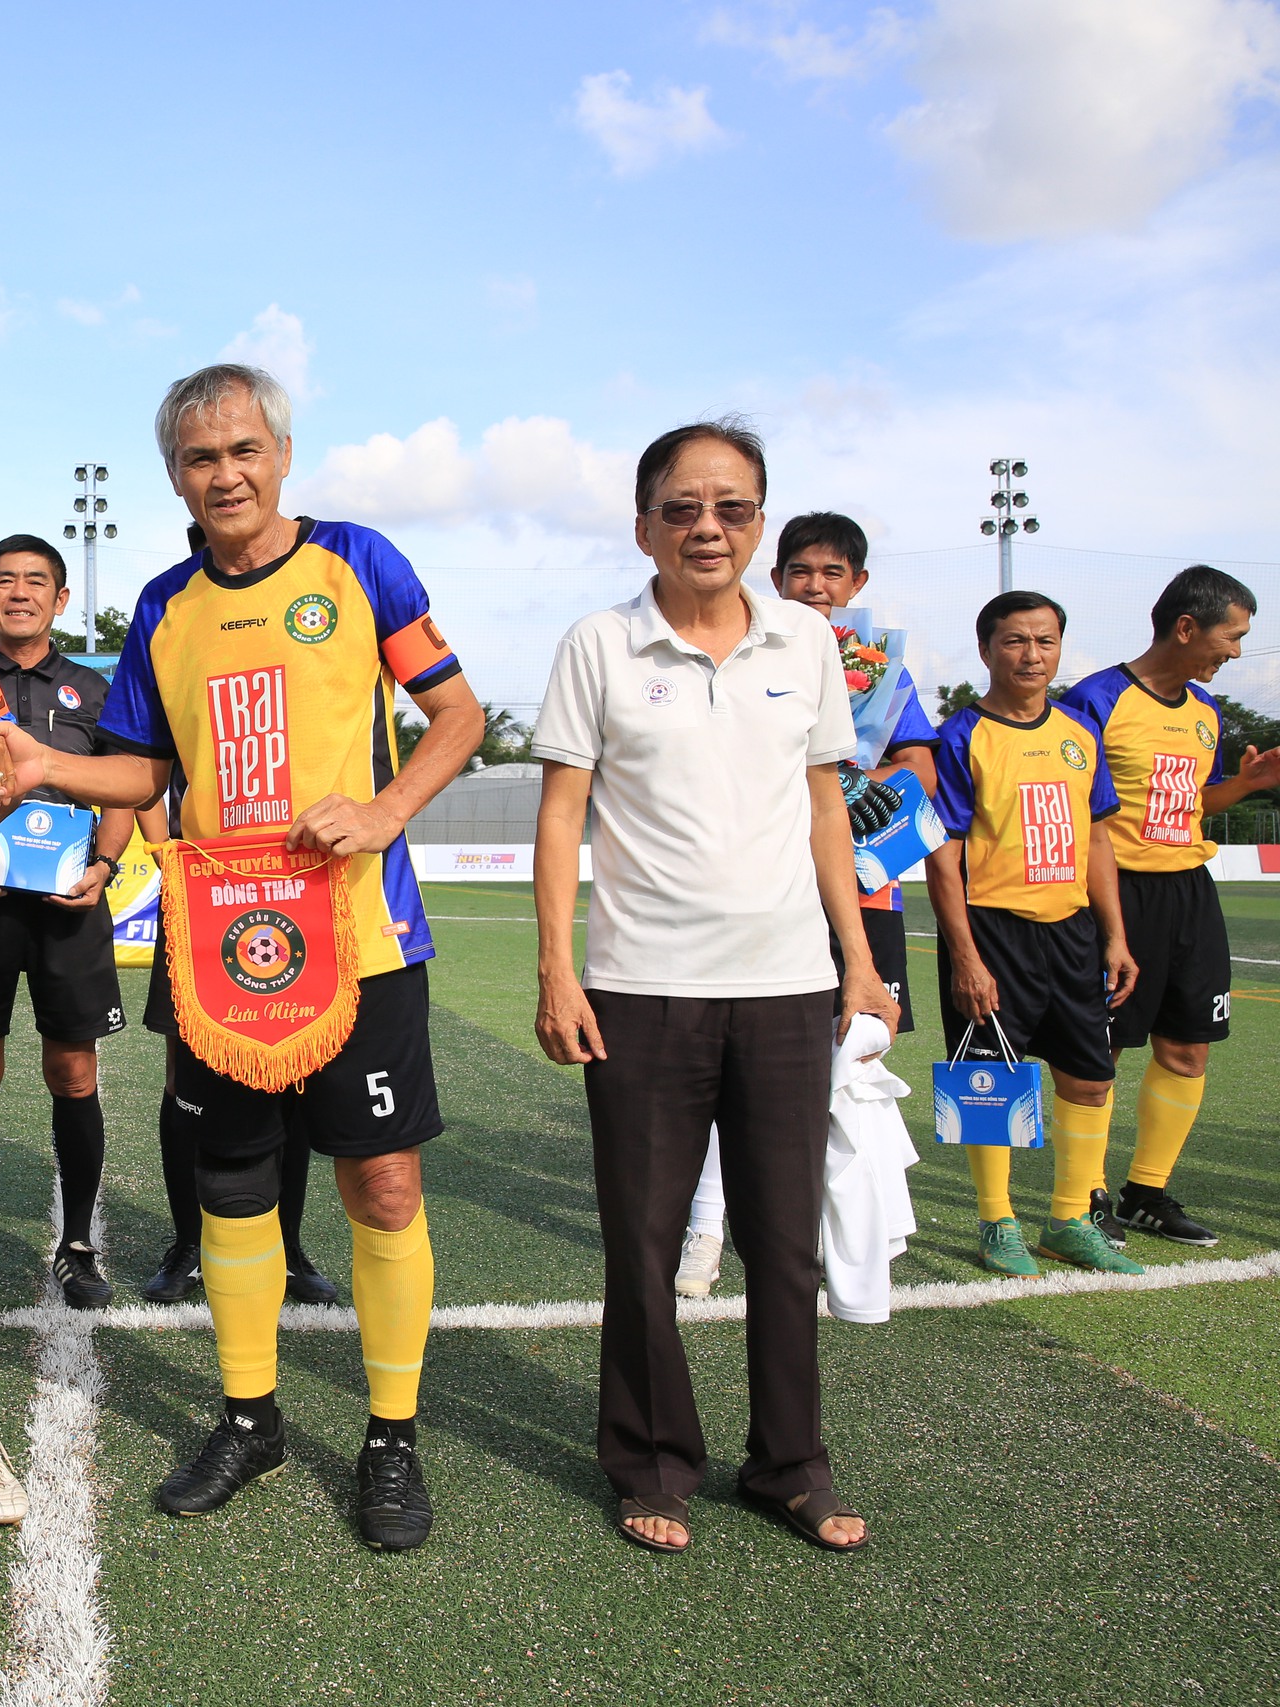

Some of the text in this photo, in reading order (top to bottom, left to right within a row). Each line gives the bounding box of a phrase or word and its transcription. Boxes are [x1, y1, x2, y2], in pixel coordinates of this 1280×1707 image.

[220, 617, 268, 631] KEEPFLY
[133, 863, 148, 876] IS
[229, 852, 283, 874] TUYỂN
[210, 876, 306, 907] ĐỒNG THÁP
[222, 1001, 318, 1024] Lưu Niệm
[1212, 992, 1230, 1022] 20
[365, 1070, 396, 1119] 5
